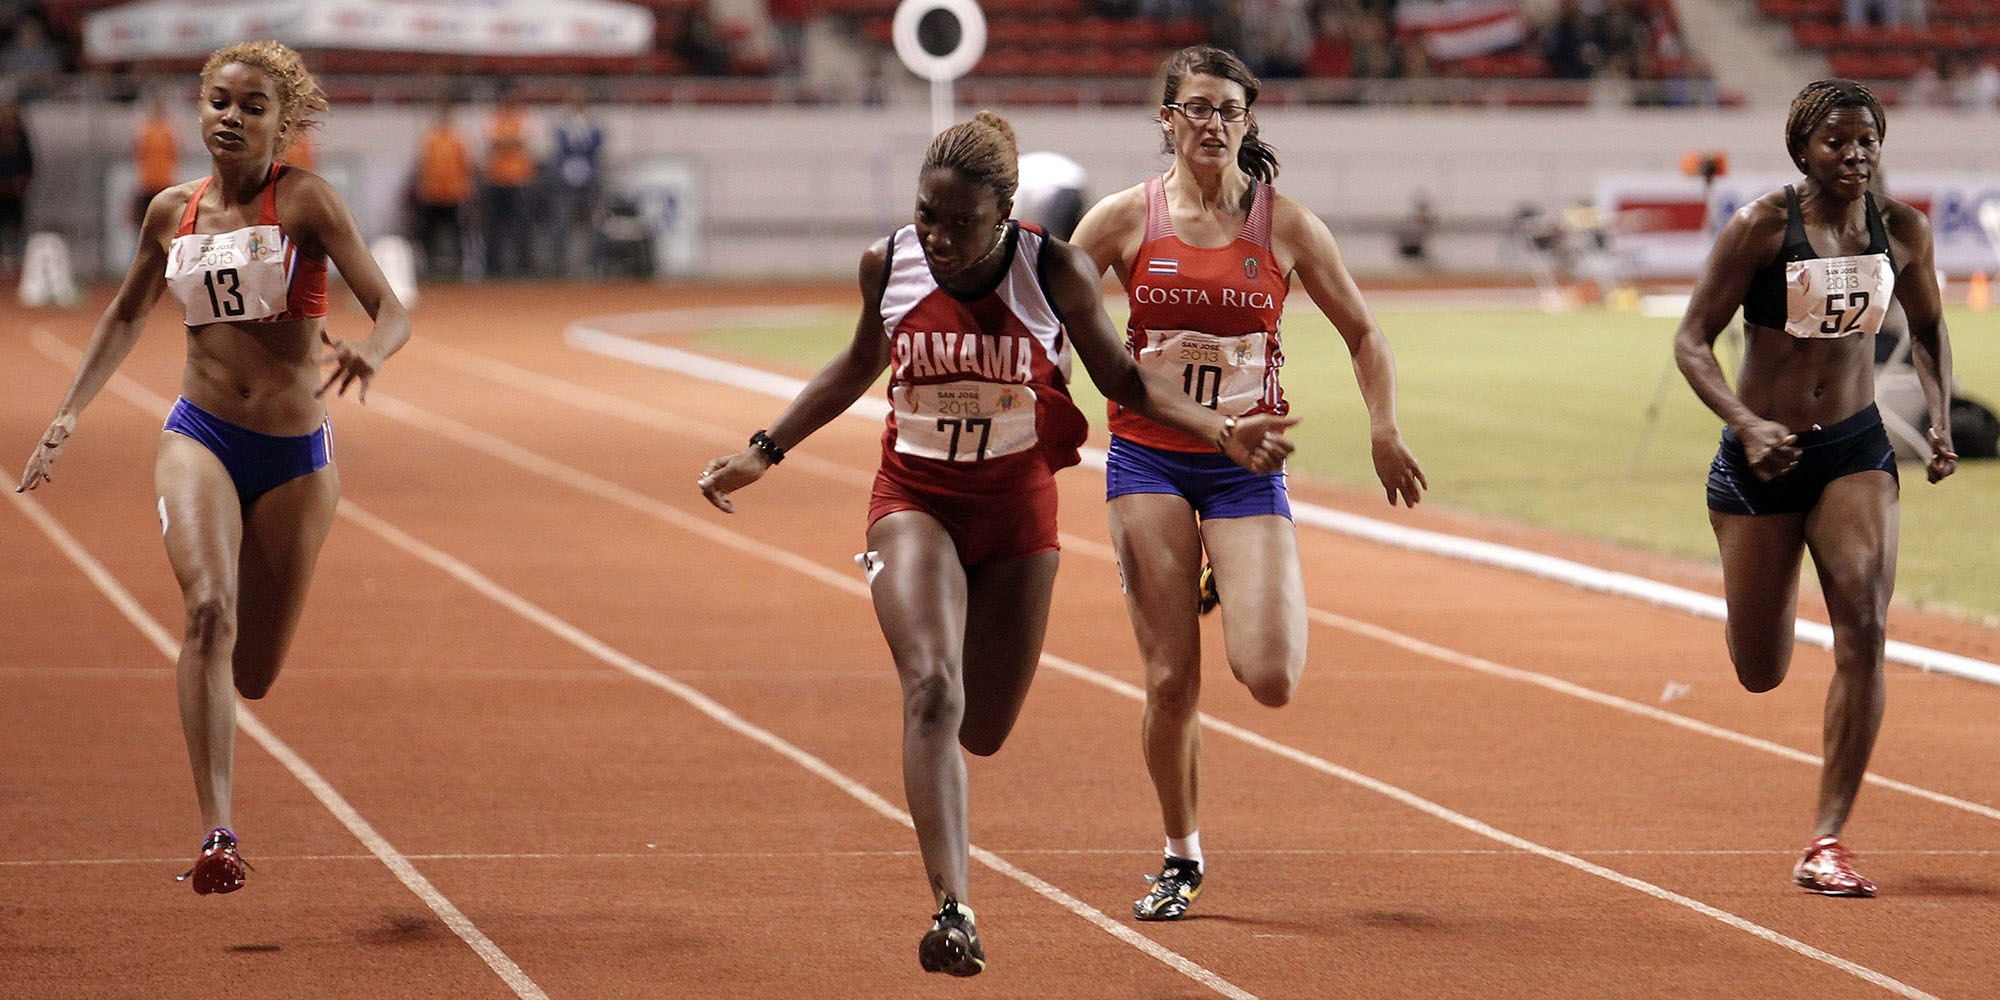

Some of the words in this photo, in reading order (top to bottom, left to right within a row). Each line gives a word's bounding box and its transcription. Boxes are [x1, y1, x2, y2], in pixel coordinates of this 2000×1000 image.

[199, 251, 233, 266] 2013
[204, 268, 245, 317] 13
[1826, 276, 1859, 290] 2013
[1135, 285, 1210, 305] COSTA
[1222, 288, 1274, 310] RICA
[1820, 291, 1869, 334] 52
[896, 332, 1033, 384] PANAMA
[1180, 349, 1218, 363] 2013
[937, 391, 955, 399] SAN
[1182, 363, 1222, 411] 10
[938, 400, 981, 415] 2013
[937, 418, 991, 461] 77
